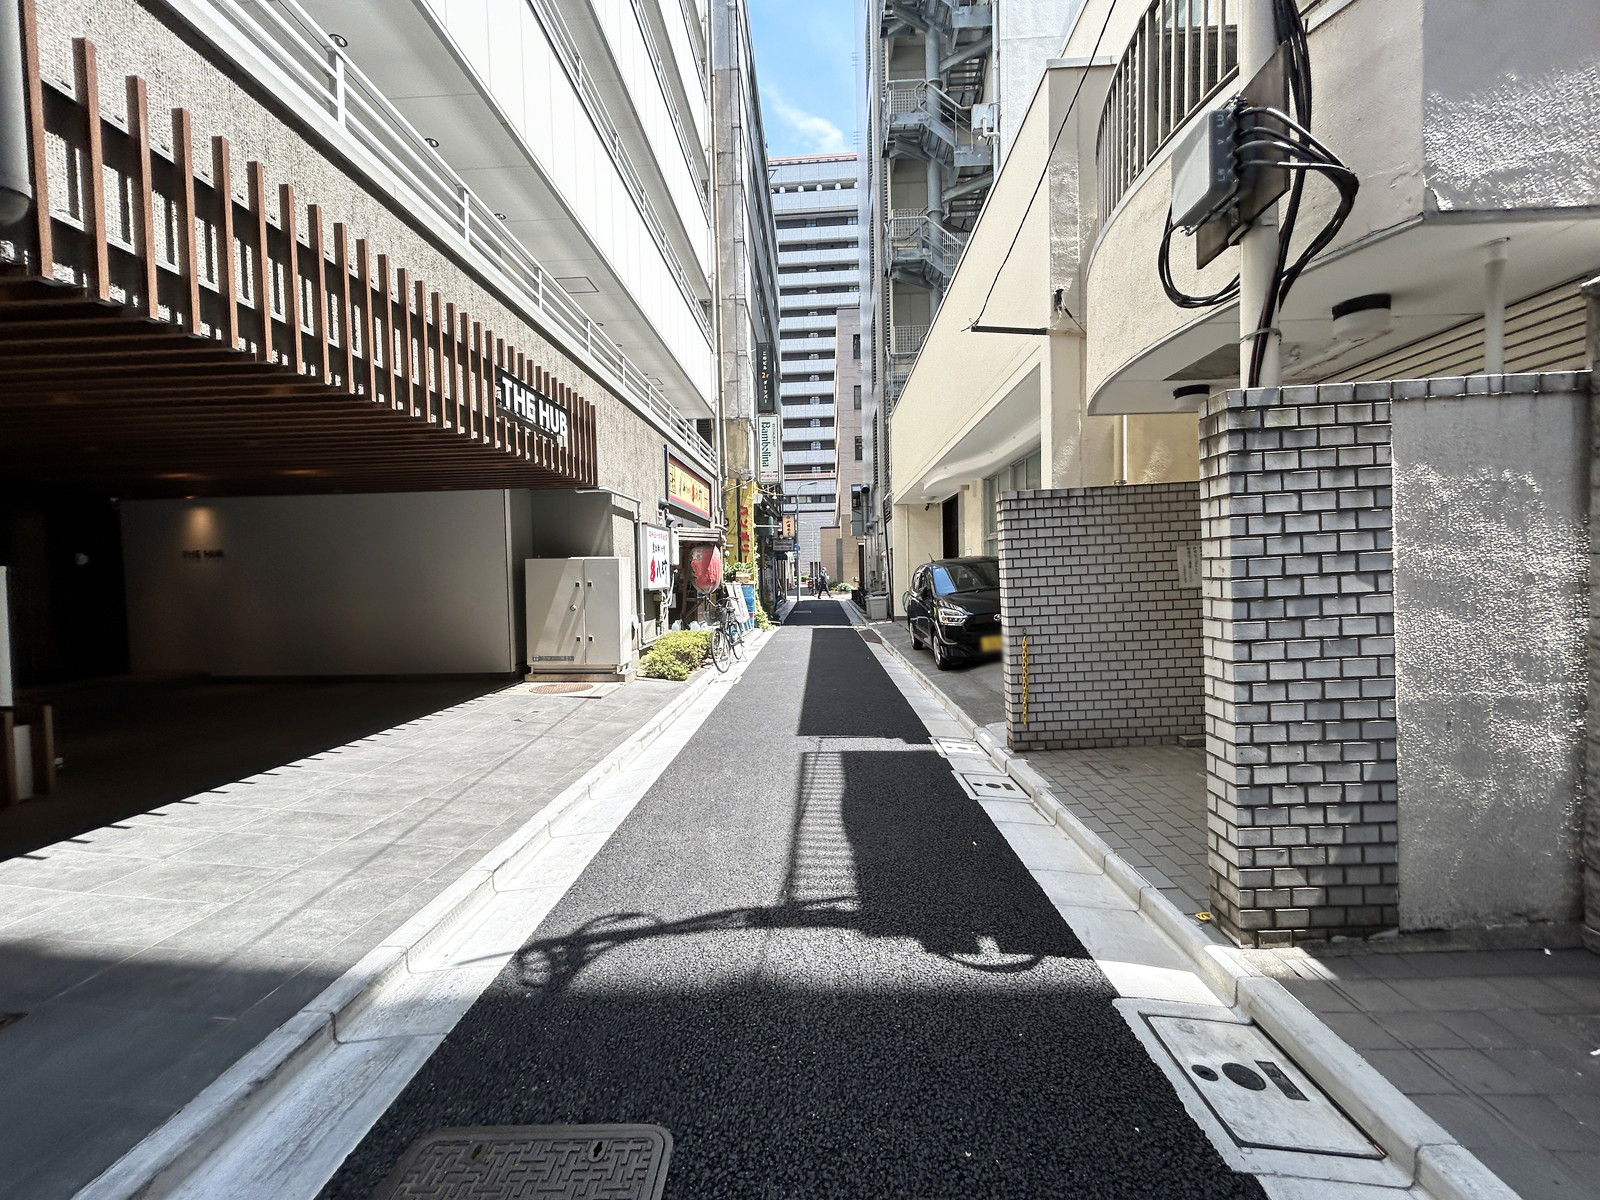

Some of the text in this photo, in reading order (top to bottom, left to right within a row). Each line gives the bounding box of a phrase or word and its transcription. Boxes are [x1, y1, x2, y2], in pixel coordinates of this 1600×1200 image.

[502, 376, 568, 437] THE HUB
[761, 421, 771, 467] Bambolina
